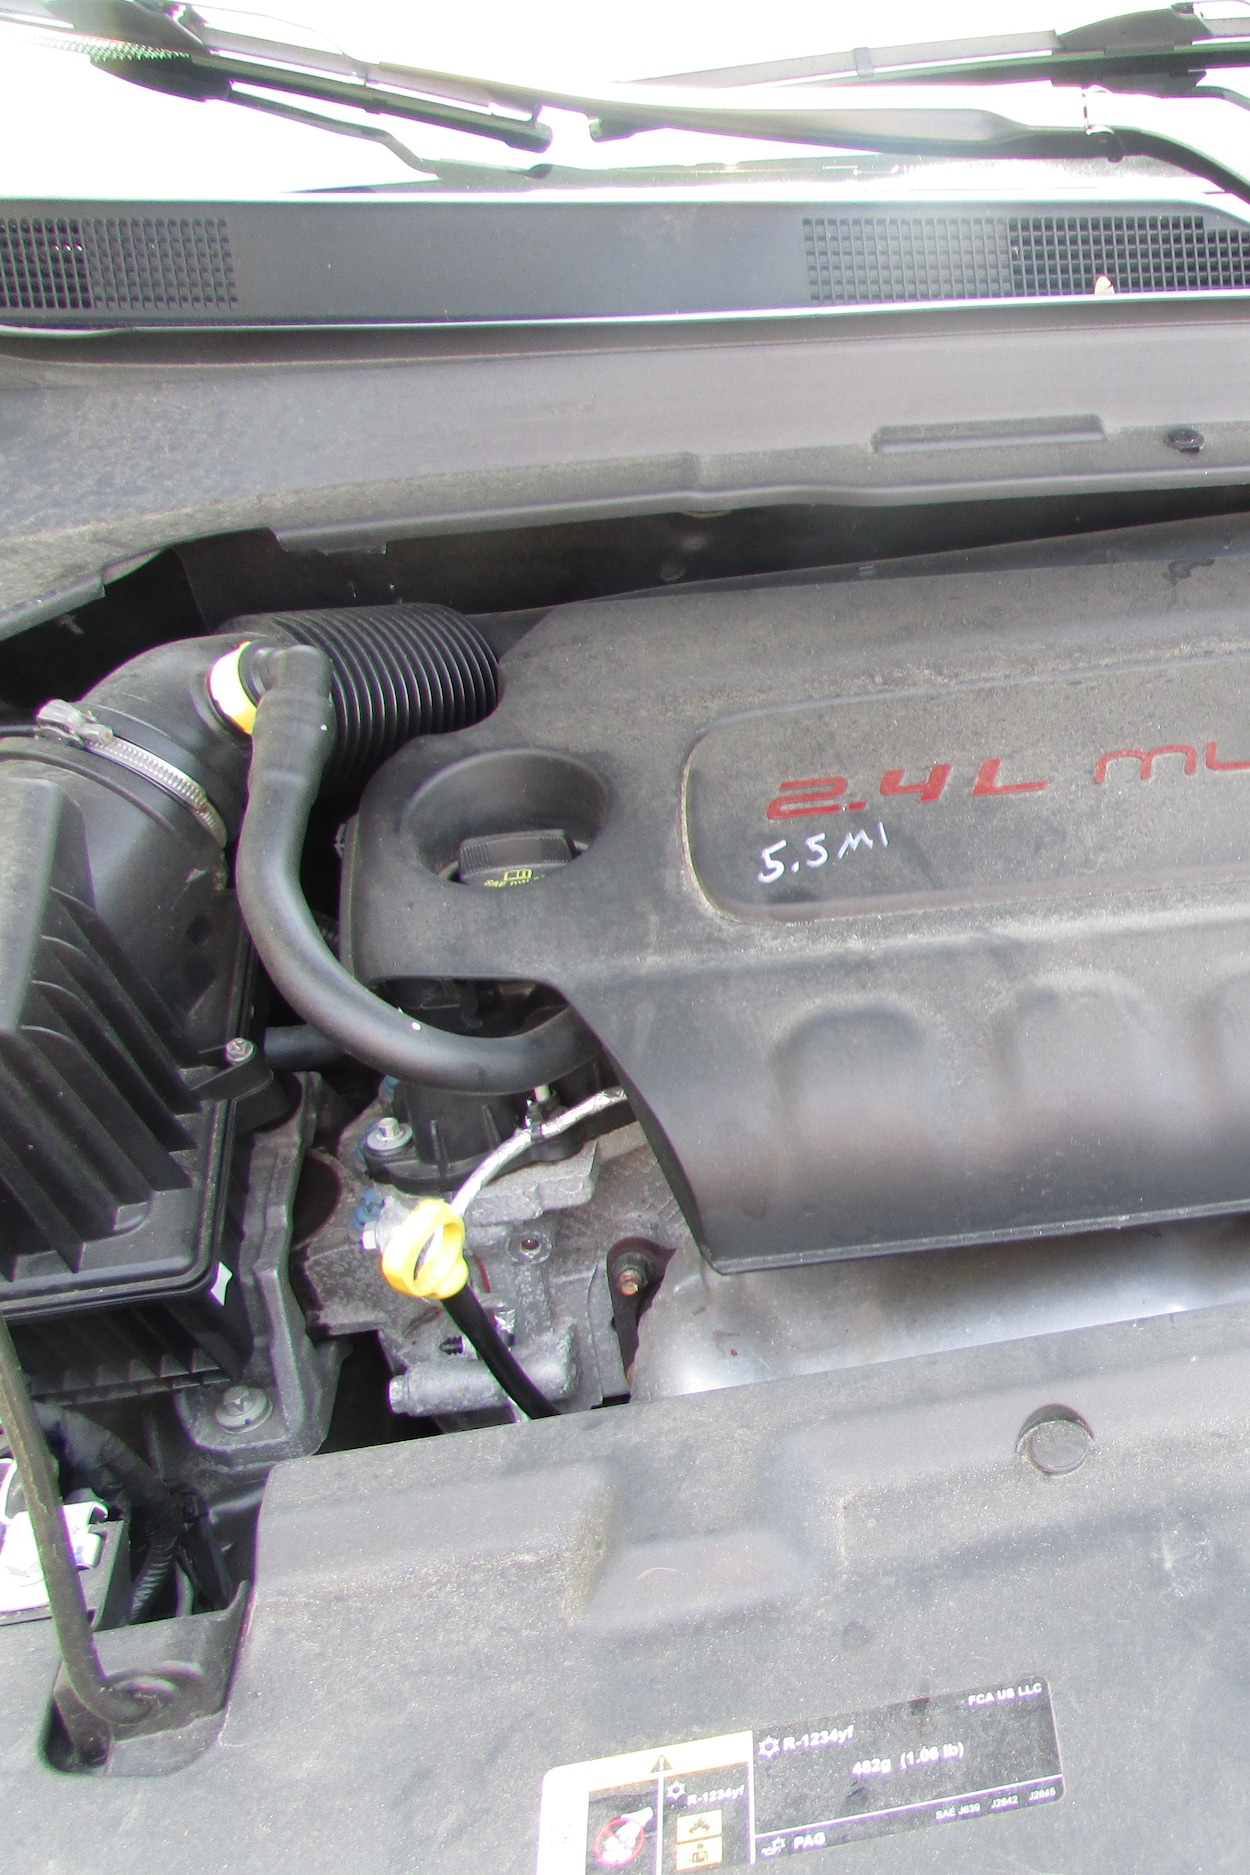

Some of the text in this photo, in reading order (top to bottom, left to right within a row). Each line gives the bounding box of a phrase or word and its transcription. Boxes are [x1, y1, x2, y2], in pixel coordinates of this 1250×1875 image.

[968, 1682, 1042, 1706] FCA US LLC
[782, 1725, 854, 1751] R-1234yf
[851, 1757, 892, 1775] 482g
[687, 1784, 745, 1806] R-1234yf
[935, 1805, 956, 1820] SAE
[793, 1832, 826, 1850] PAG
